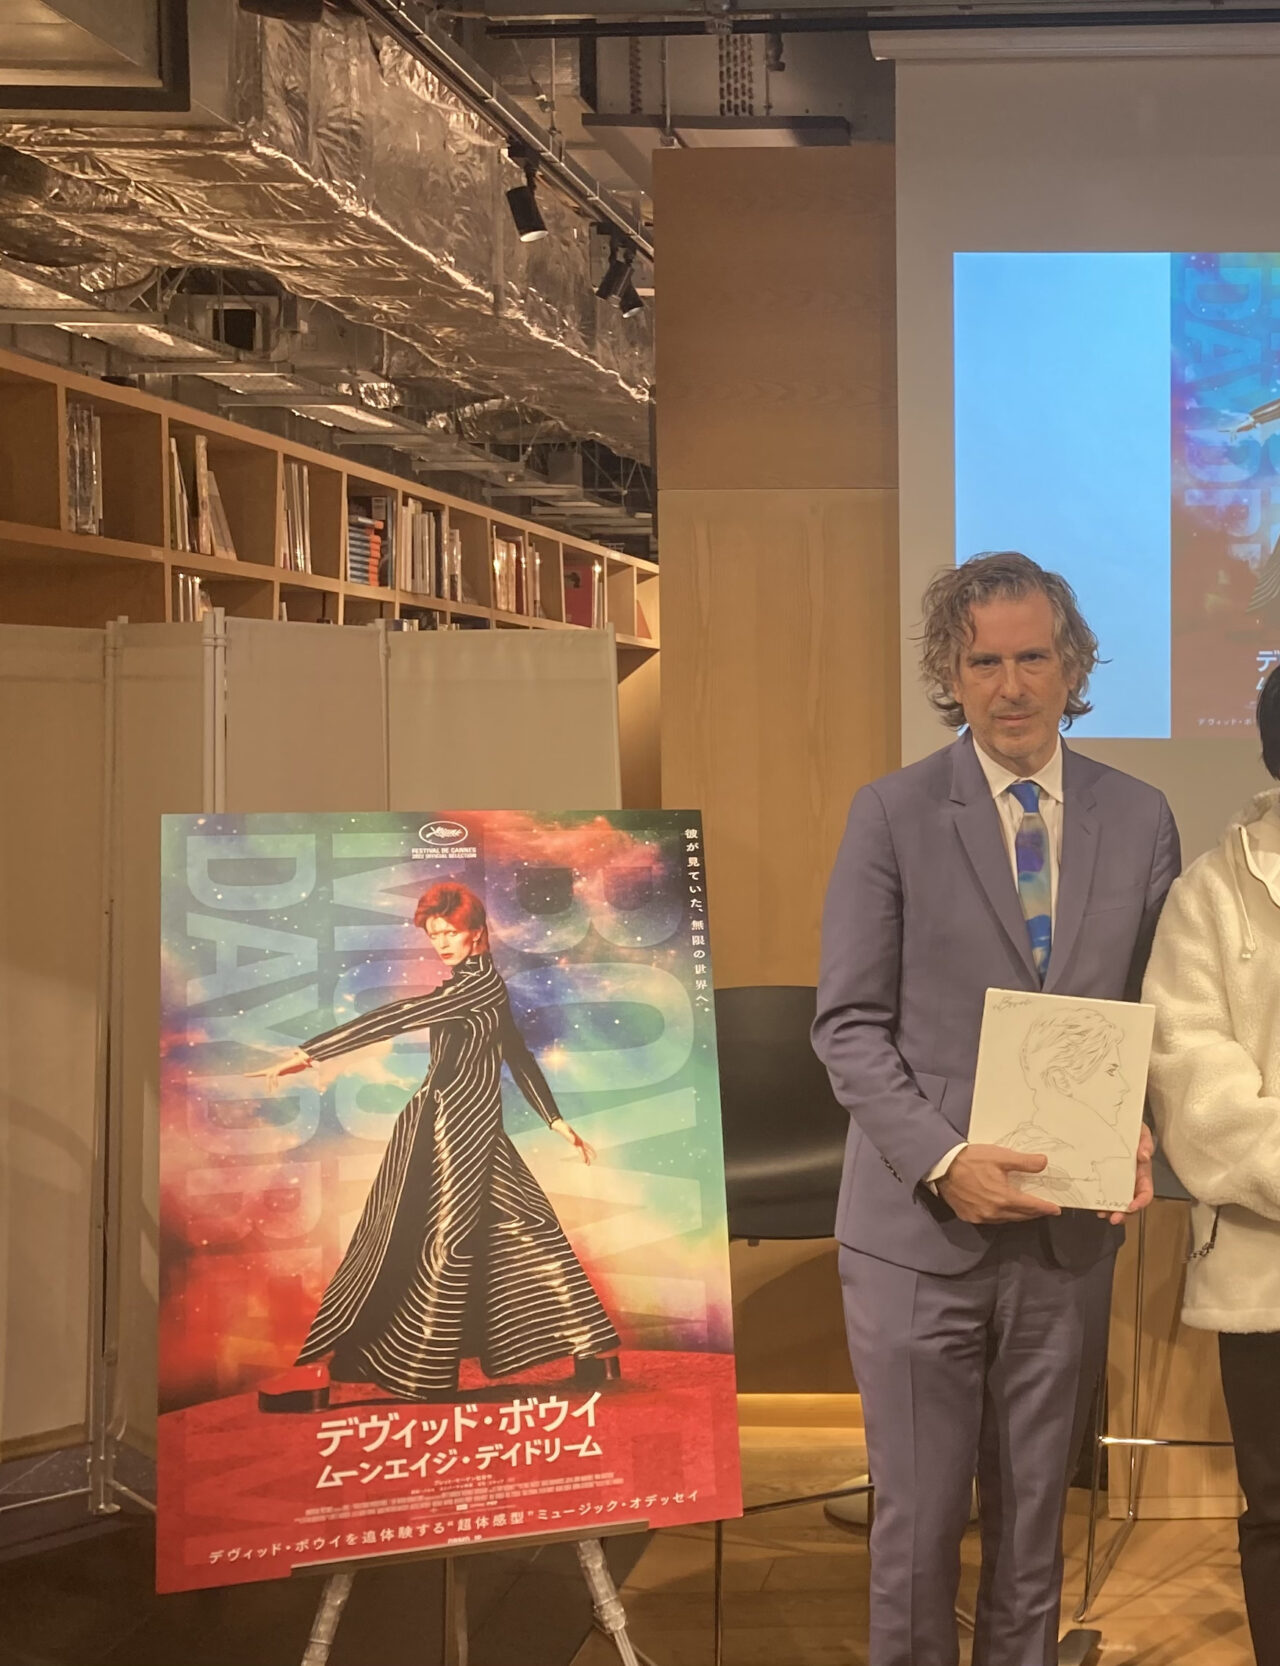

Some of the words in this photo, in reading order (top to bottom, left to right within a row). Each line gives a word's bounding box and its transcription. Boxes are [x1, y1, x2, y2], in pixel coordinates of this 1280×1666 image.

[316, 1391, 602, 1457] デヴィッド・ボウイ
[316, 1434, 603, 1489] ムーンエイジ・デイドリーム
